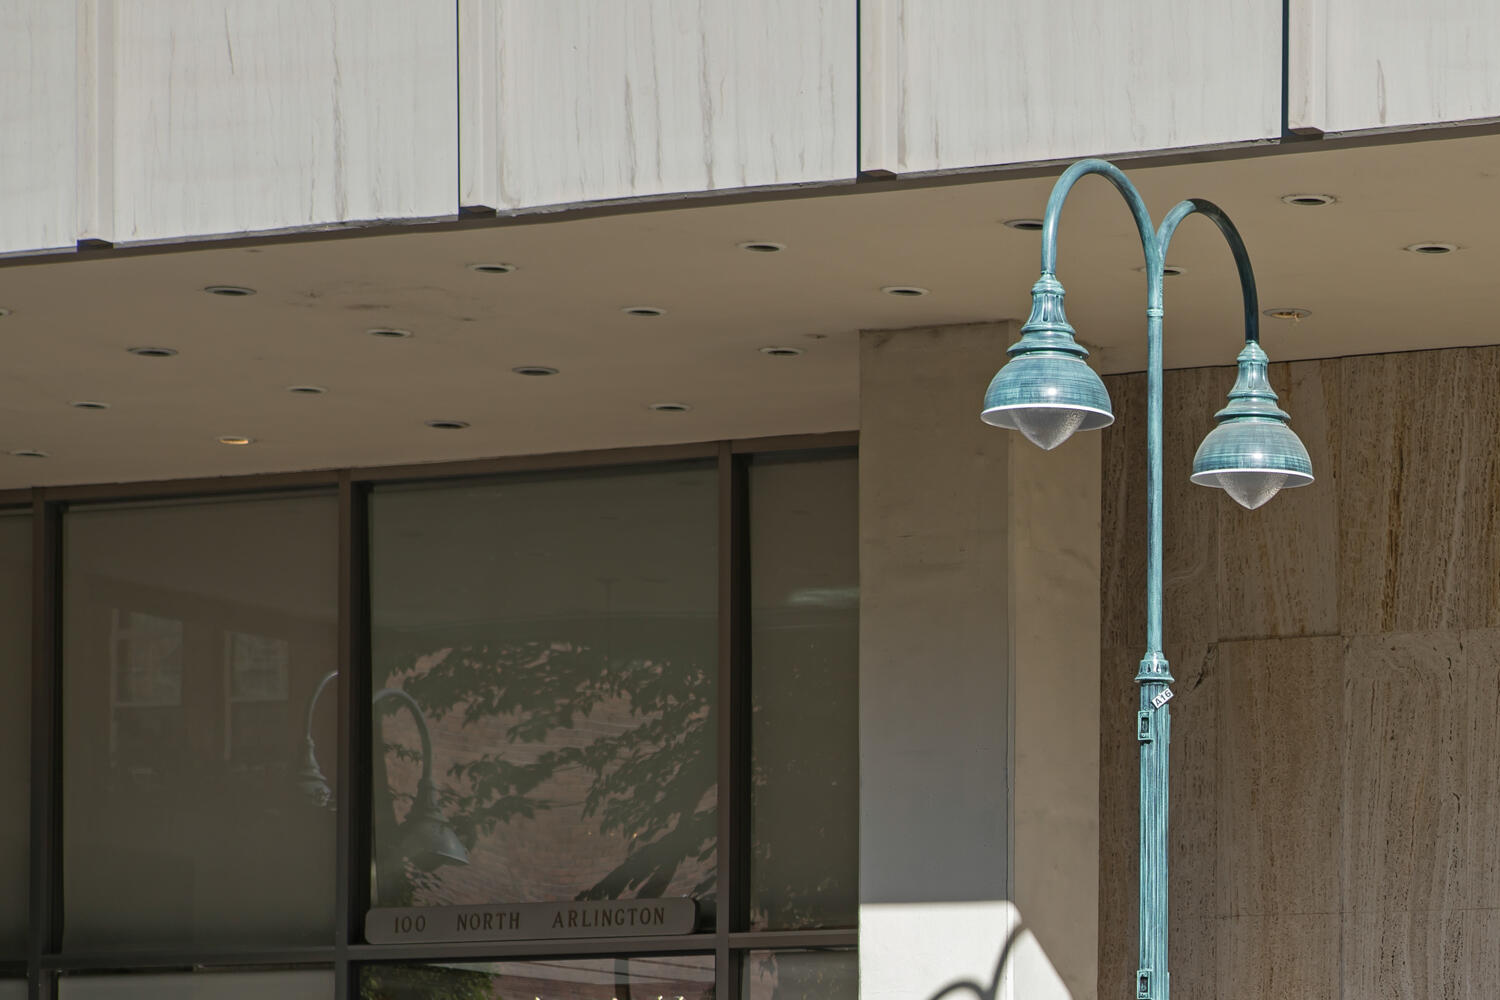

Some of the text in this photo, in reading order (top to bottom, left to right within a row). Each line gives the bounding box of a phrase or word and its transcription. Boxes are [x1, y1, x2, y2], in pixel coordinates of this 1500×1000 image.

[1155, 690, 1171, 706] A16
[394, 907, 665, 933] 100 NORTH ARLINGTON
